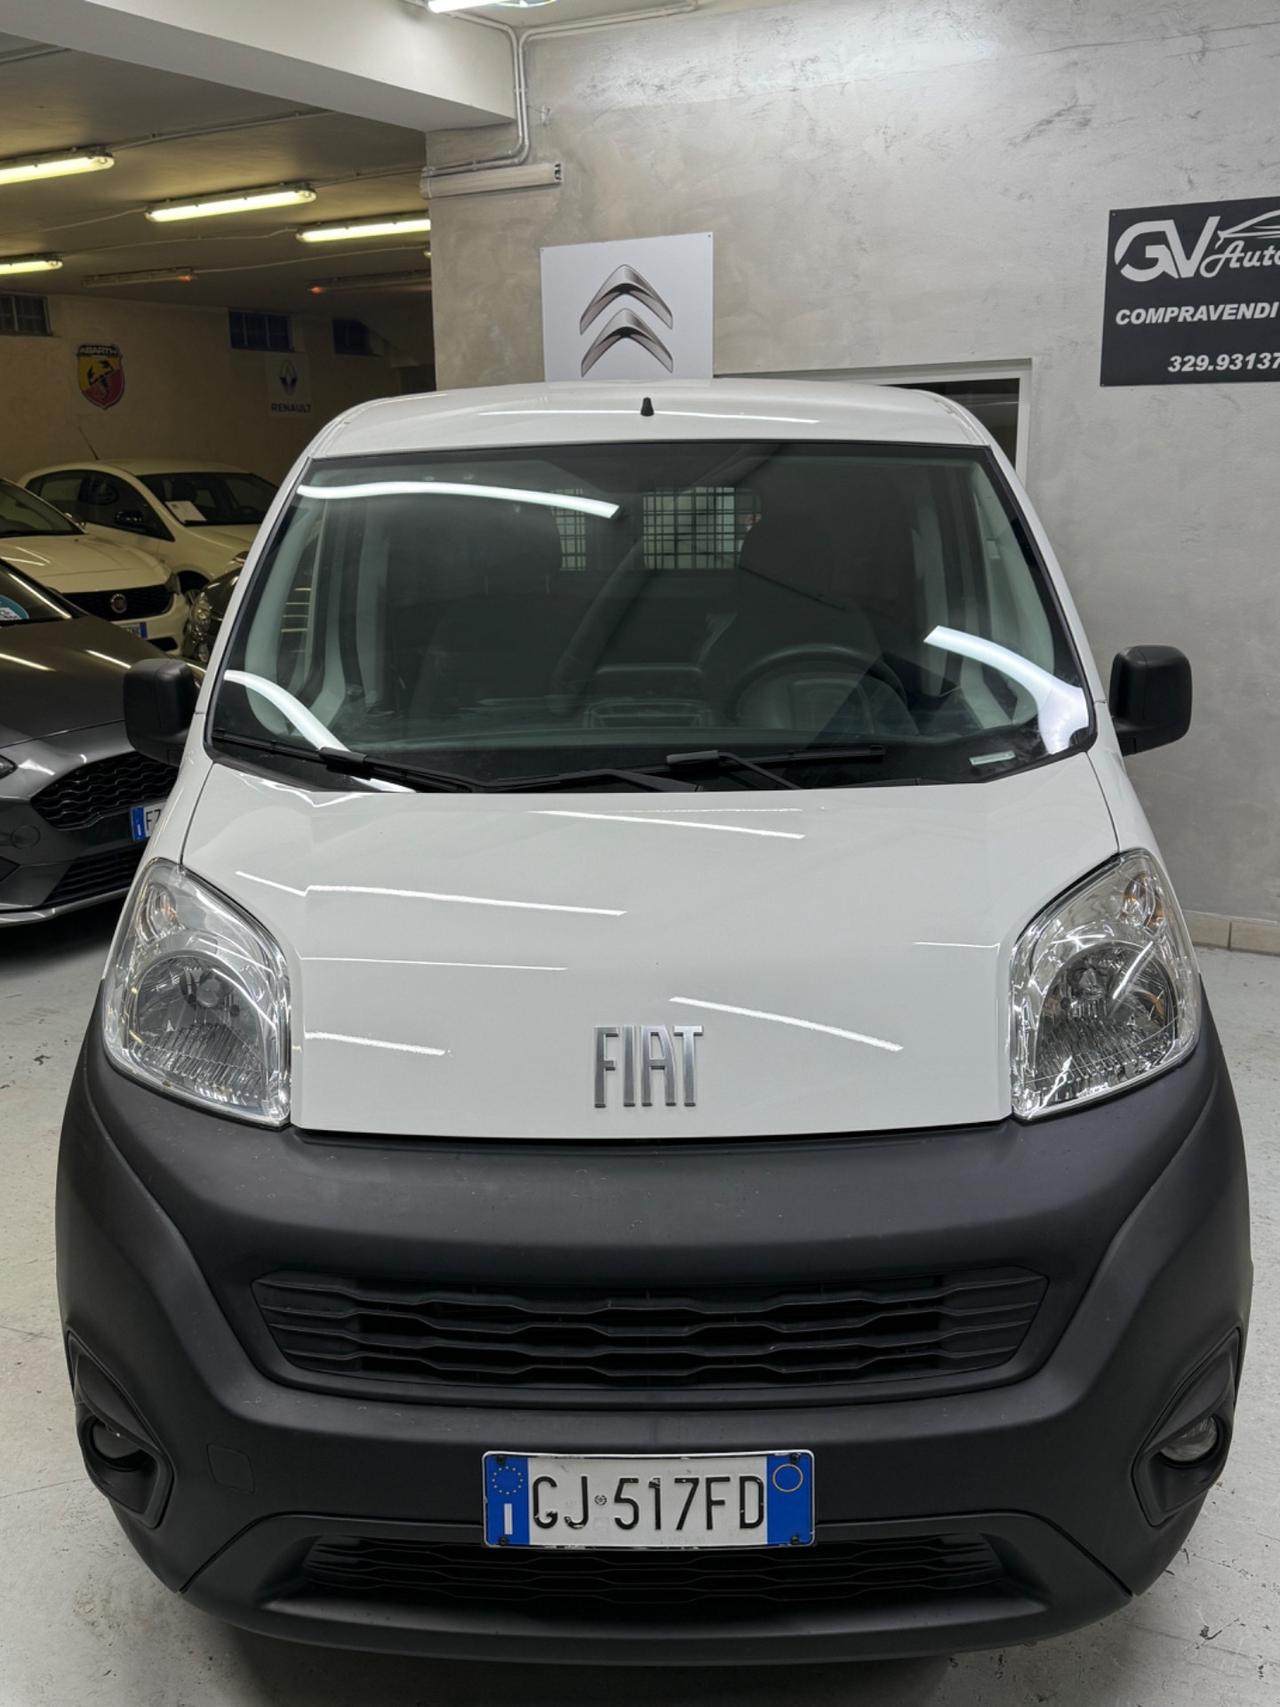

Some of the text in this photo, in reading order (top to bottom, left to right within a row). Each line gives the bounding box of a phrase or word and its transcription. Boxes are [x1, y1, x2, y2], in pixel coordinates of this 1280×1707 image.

[1114, 216, 1221, 282] GV
[1115, 302, 1279, 325] COMPRAVENDI
[271, 402, 312, 413] RENAULT
[593, 1024, 704, 1108] FIAT
